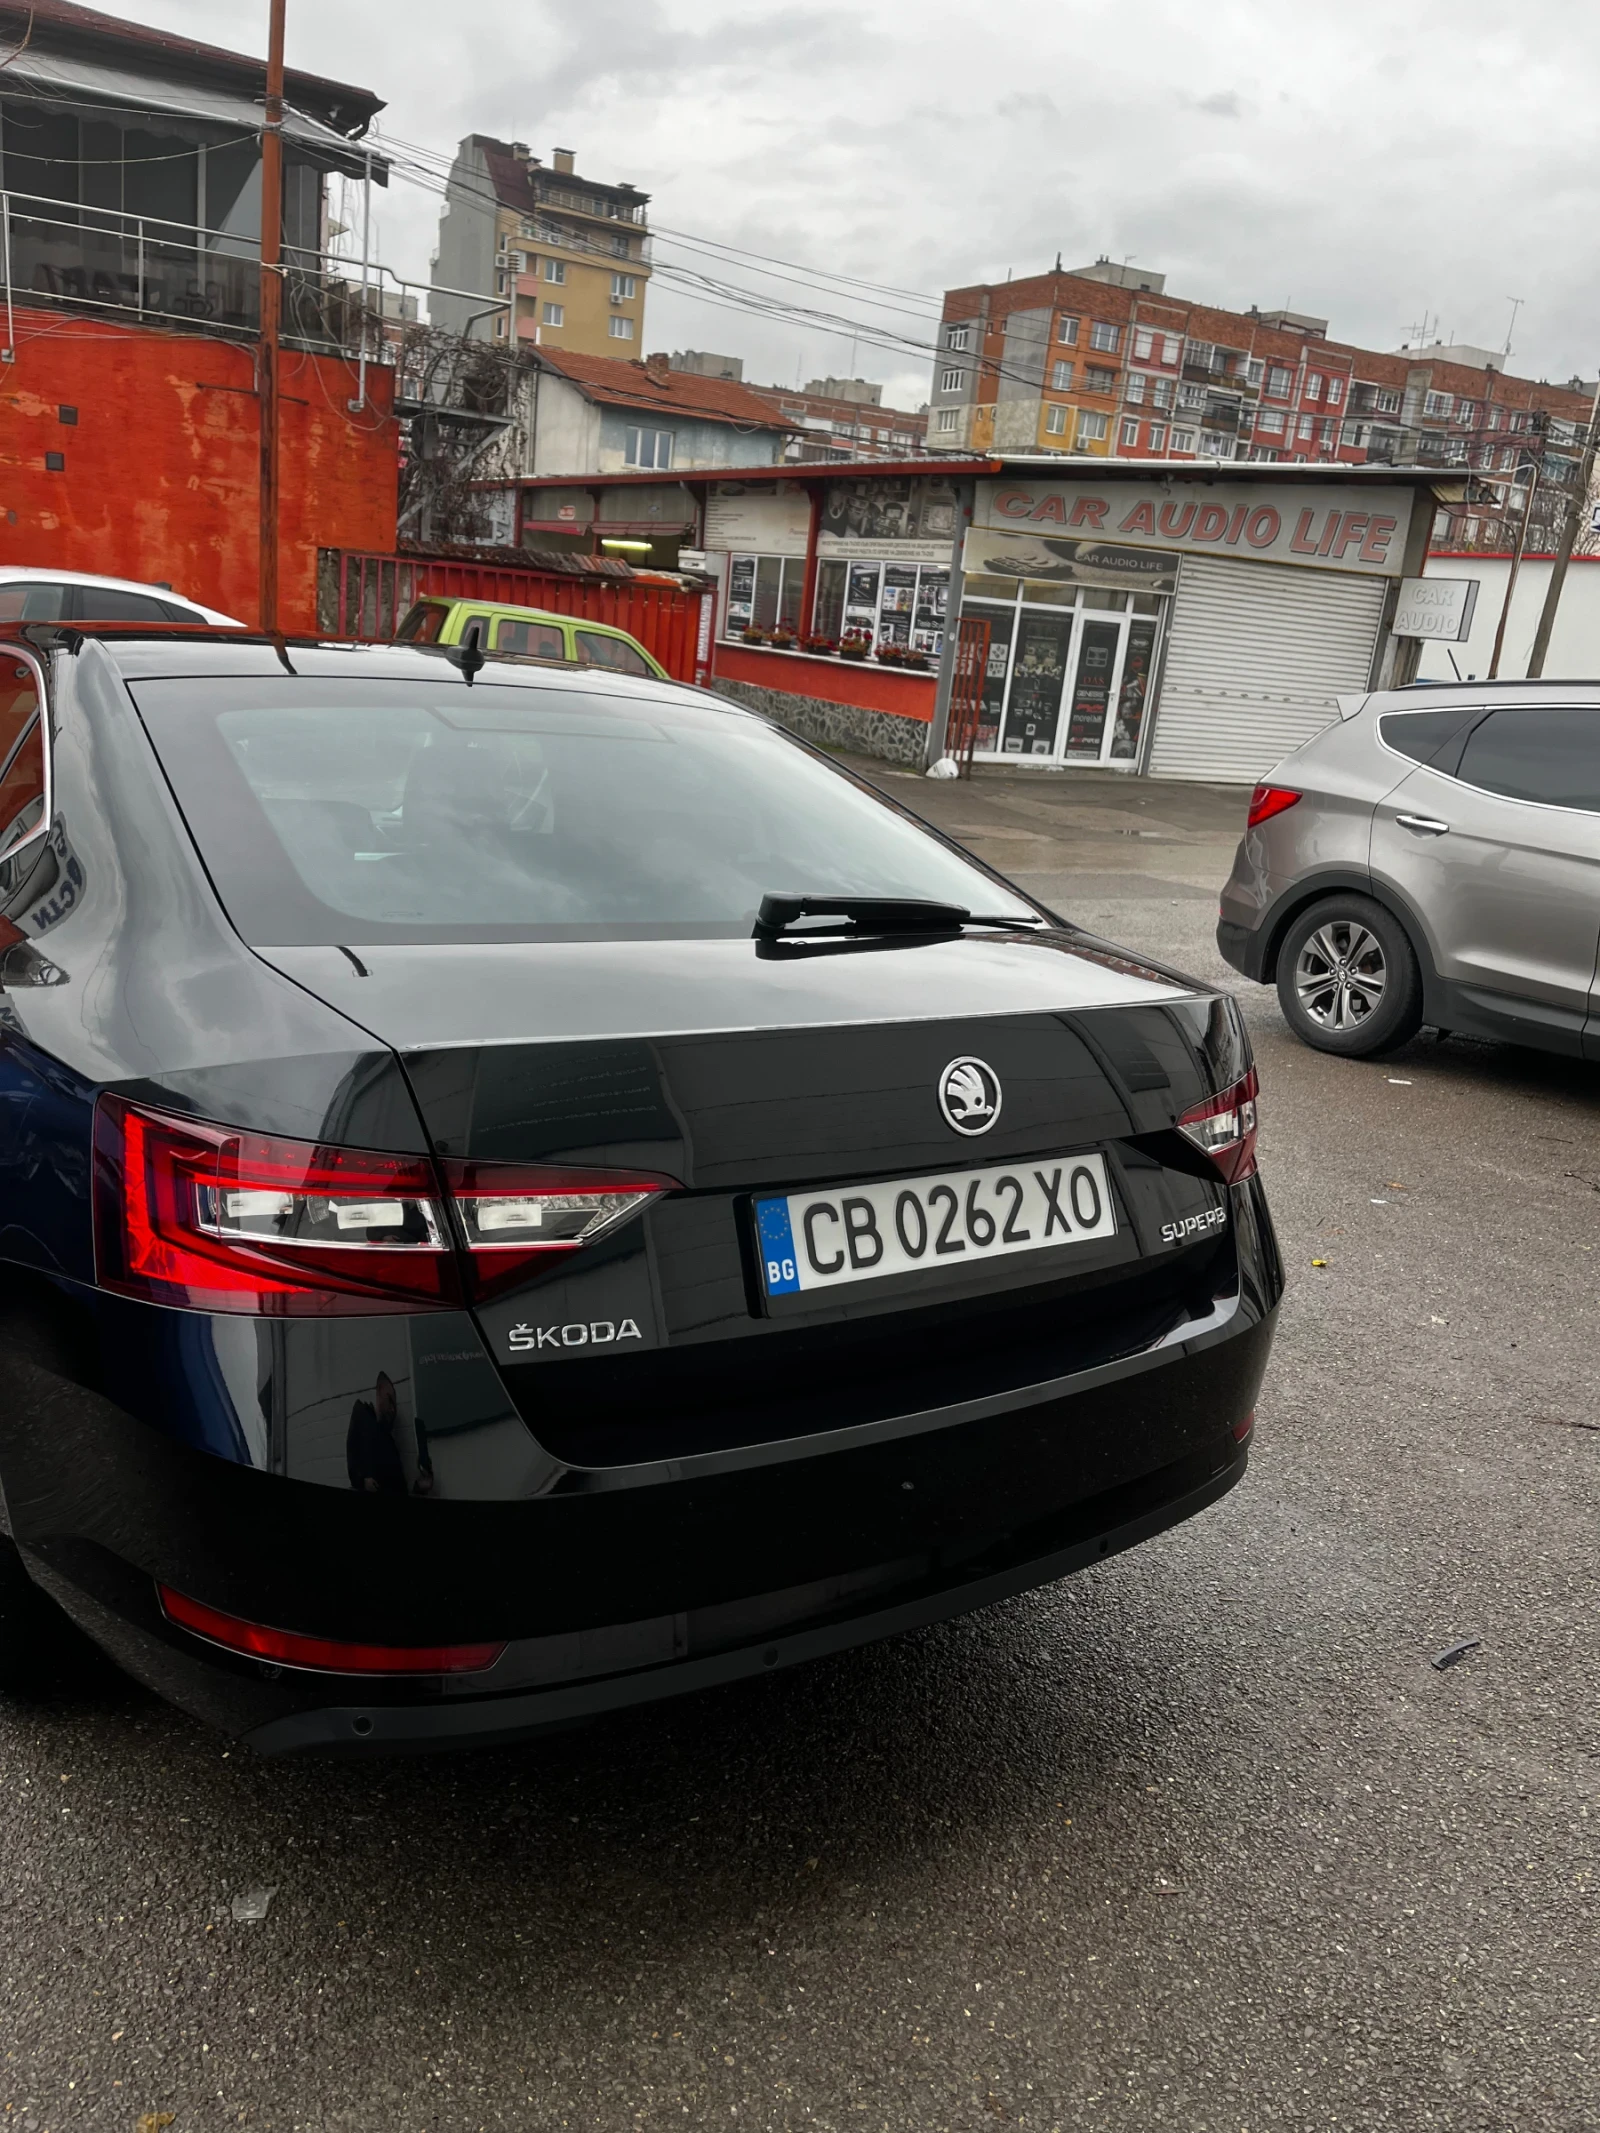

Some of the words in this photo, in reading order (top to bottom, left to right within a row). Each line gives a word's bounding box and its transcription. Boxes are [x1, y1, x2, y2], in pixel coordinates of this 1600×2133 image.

[994, 489, 1110, 530] CAR
[1118, 500, 1281, 548] AUDIO
[1290, 507, 1398, 564] LIFE
[1075, 553, 1100, 564] CAR
[1102, 555, 1137, 569] AUDIO
[1140, 560, 1163, 571] LIFE
[1412, 585, 1455, 606] CAR
[1395, 611, 1459, 634] AUDIO
[803, 1196, 884, 1275] CB
[895, 1175, 1031, 1260] 0262
[1033, 1166, 1101, 1237] XO
[1160, 1206, 1226, 1242] SUPERB
[767, 1258, 795, 1284] BG
[508, 1318, 643, 1351] ŠKODA
